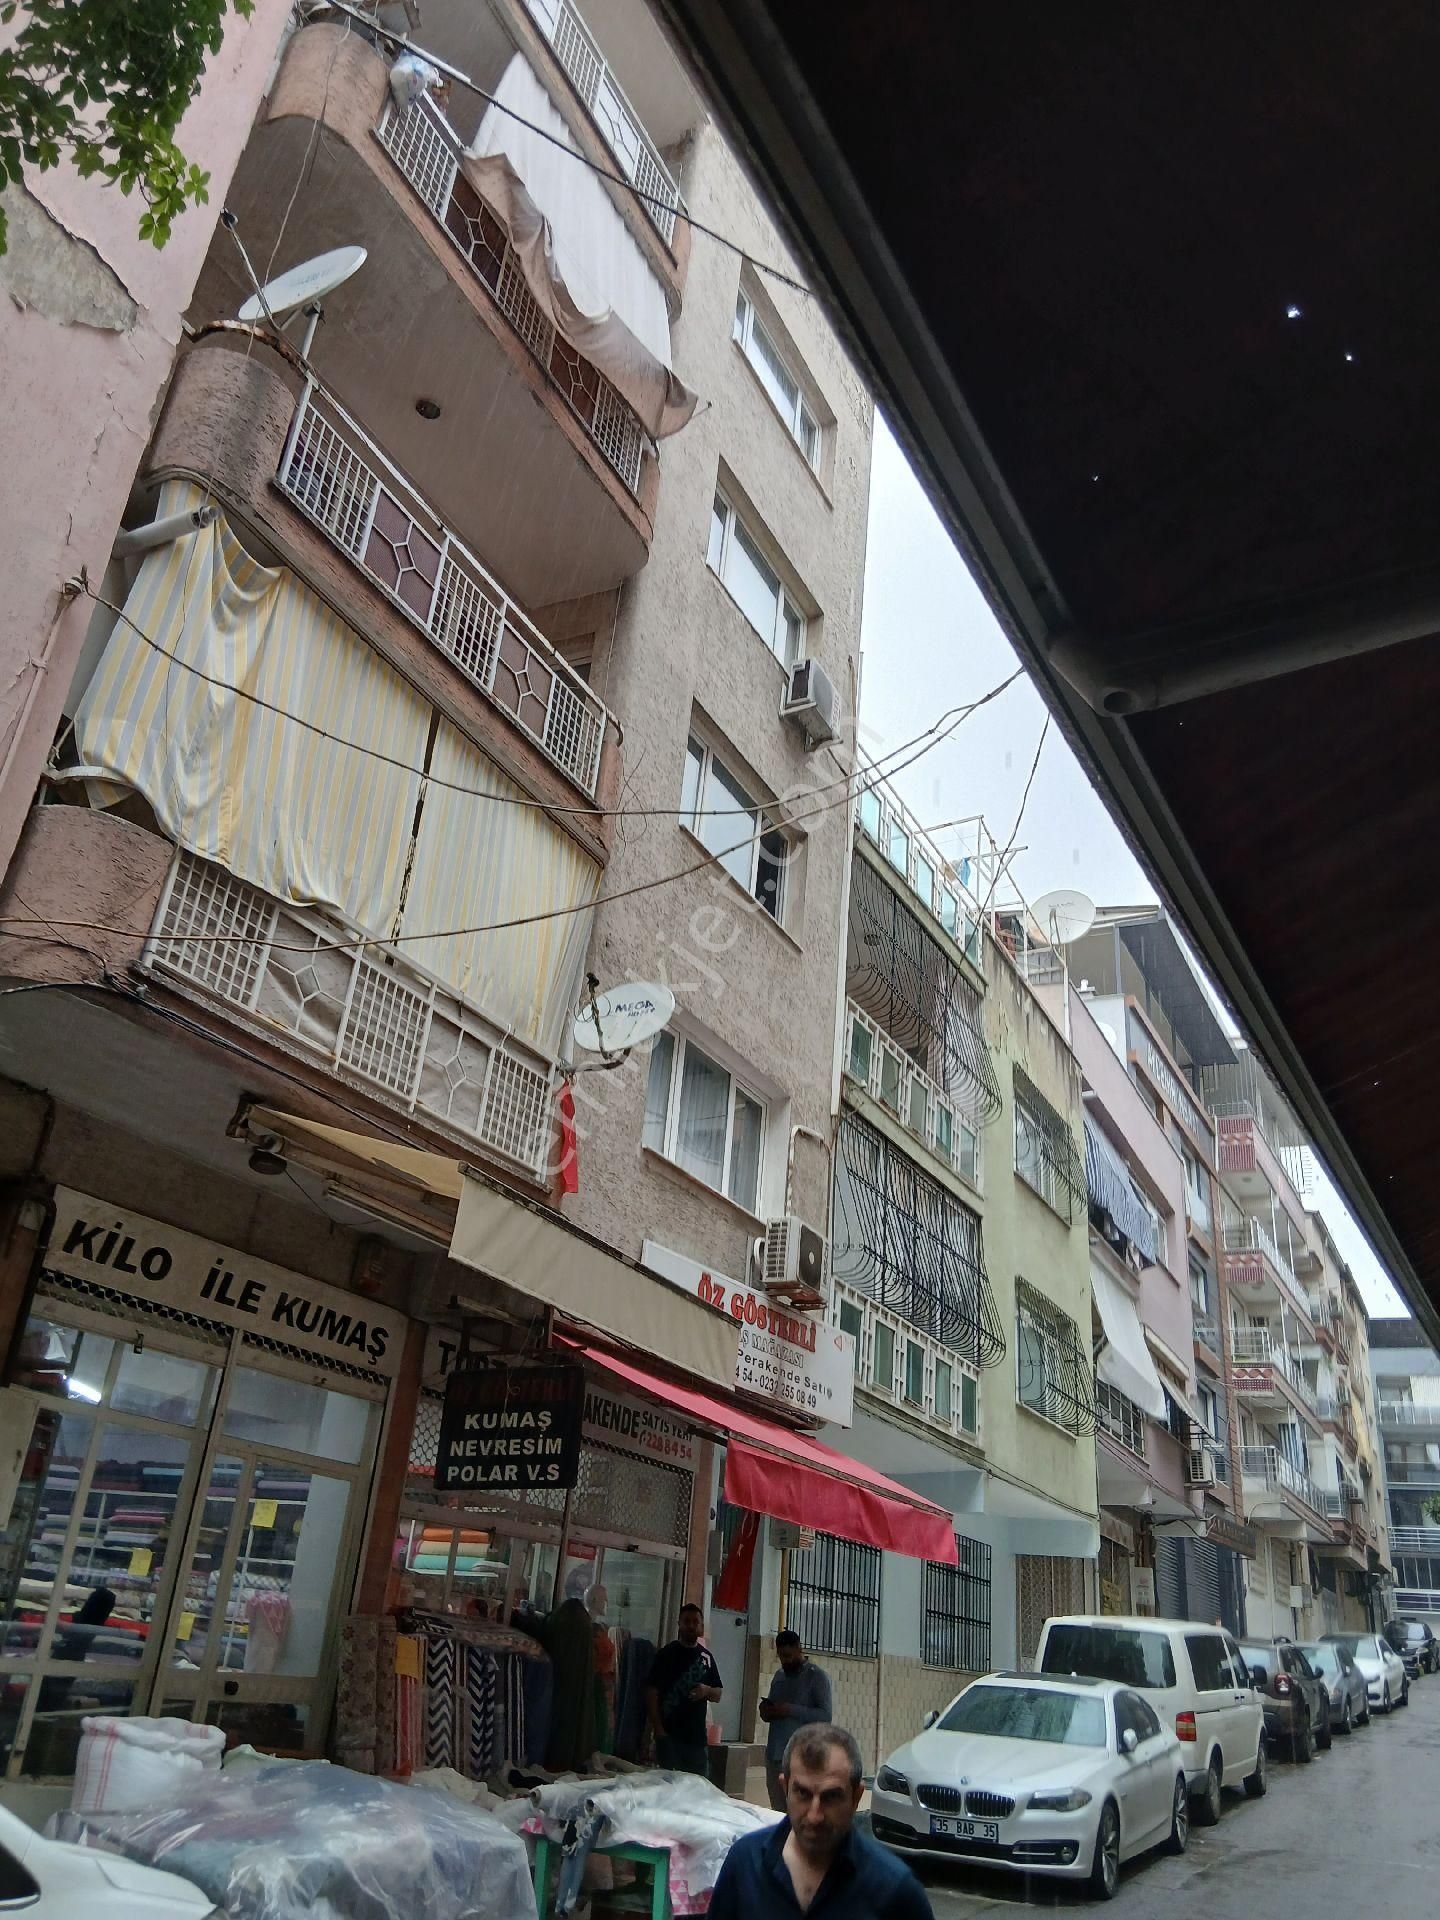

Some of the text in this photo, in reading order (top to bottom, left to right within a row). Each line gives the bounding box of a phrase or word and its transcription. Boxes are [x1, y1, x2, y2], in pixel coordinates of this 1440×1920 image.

[62, 1219, 173, 1281] KİLO
[200, 1257, 266, 1314] İLE
[272, 1292, 390, 1365] KUMAŞ
[697, 1271, 726, 1311] ÖZ
[464, 1410, 553, 1432] KUMAŞ
[449, 1434, 563, 1457] NEVRESİM
[447, 1464, 560, 1482] POLAR V.S
[936, 1819, 995, 1838] 35 BAB 35
